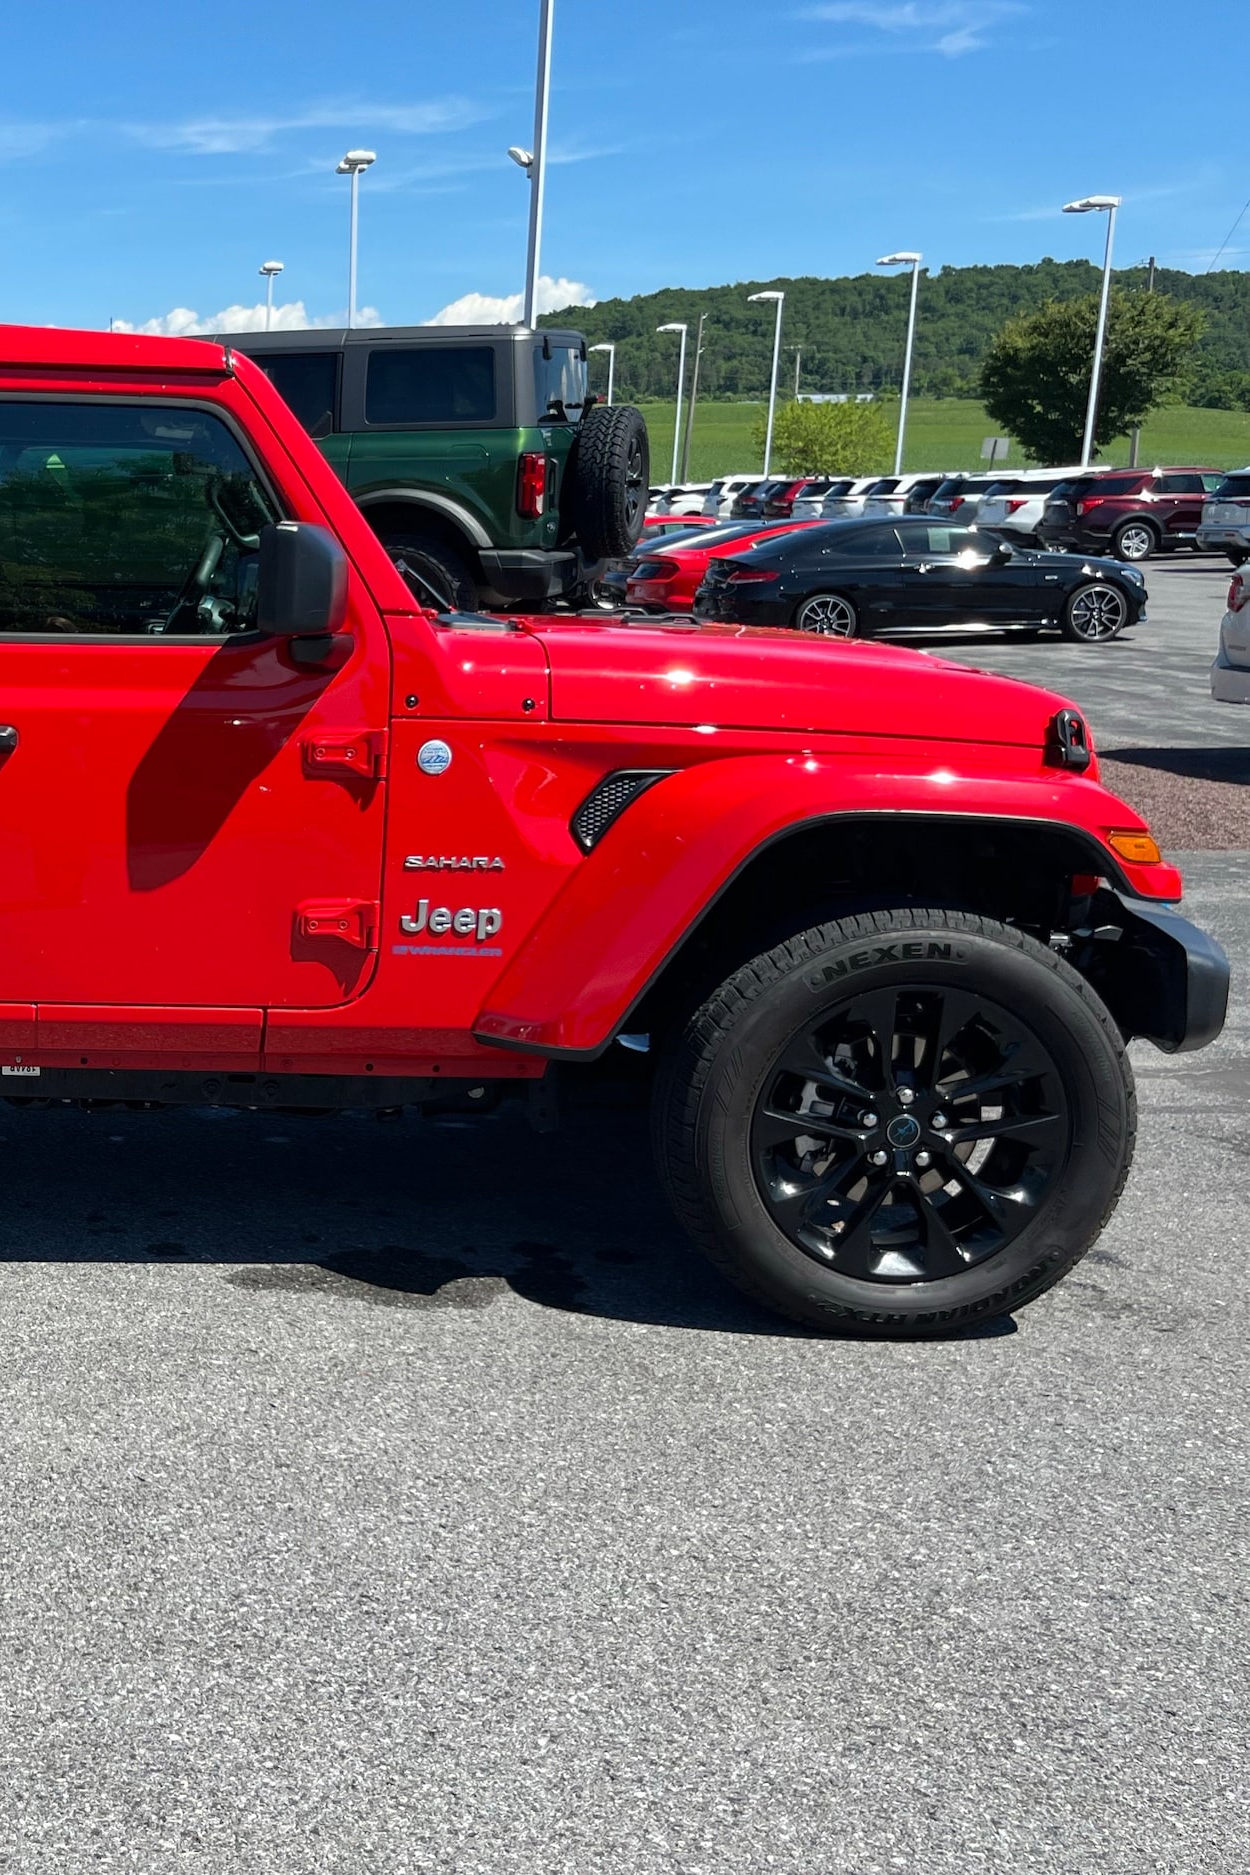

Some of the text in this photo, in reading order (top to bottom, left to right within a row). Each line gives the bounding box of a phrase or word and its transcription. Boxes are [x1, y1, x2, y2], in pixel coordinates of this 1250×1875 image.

[404, 855, 505, 870] SAHARA
[400, 899, 502, 941] Jeep
[822, 942, 952, 982] NEXEN
